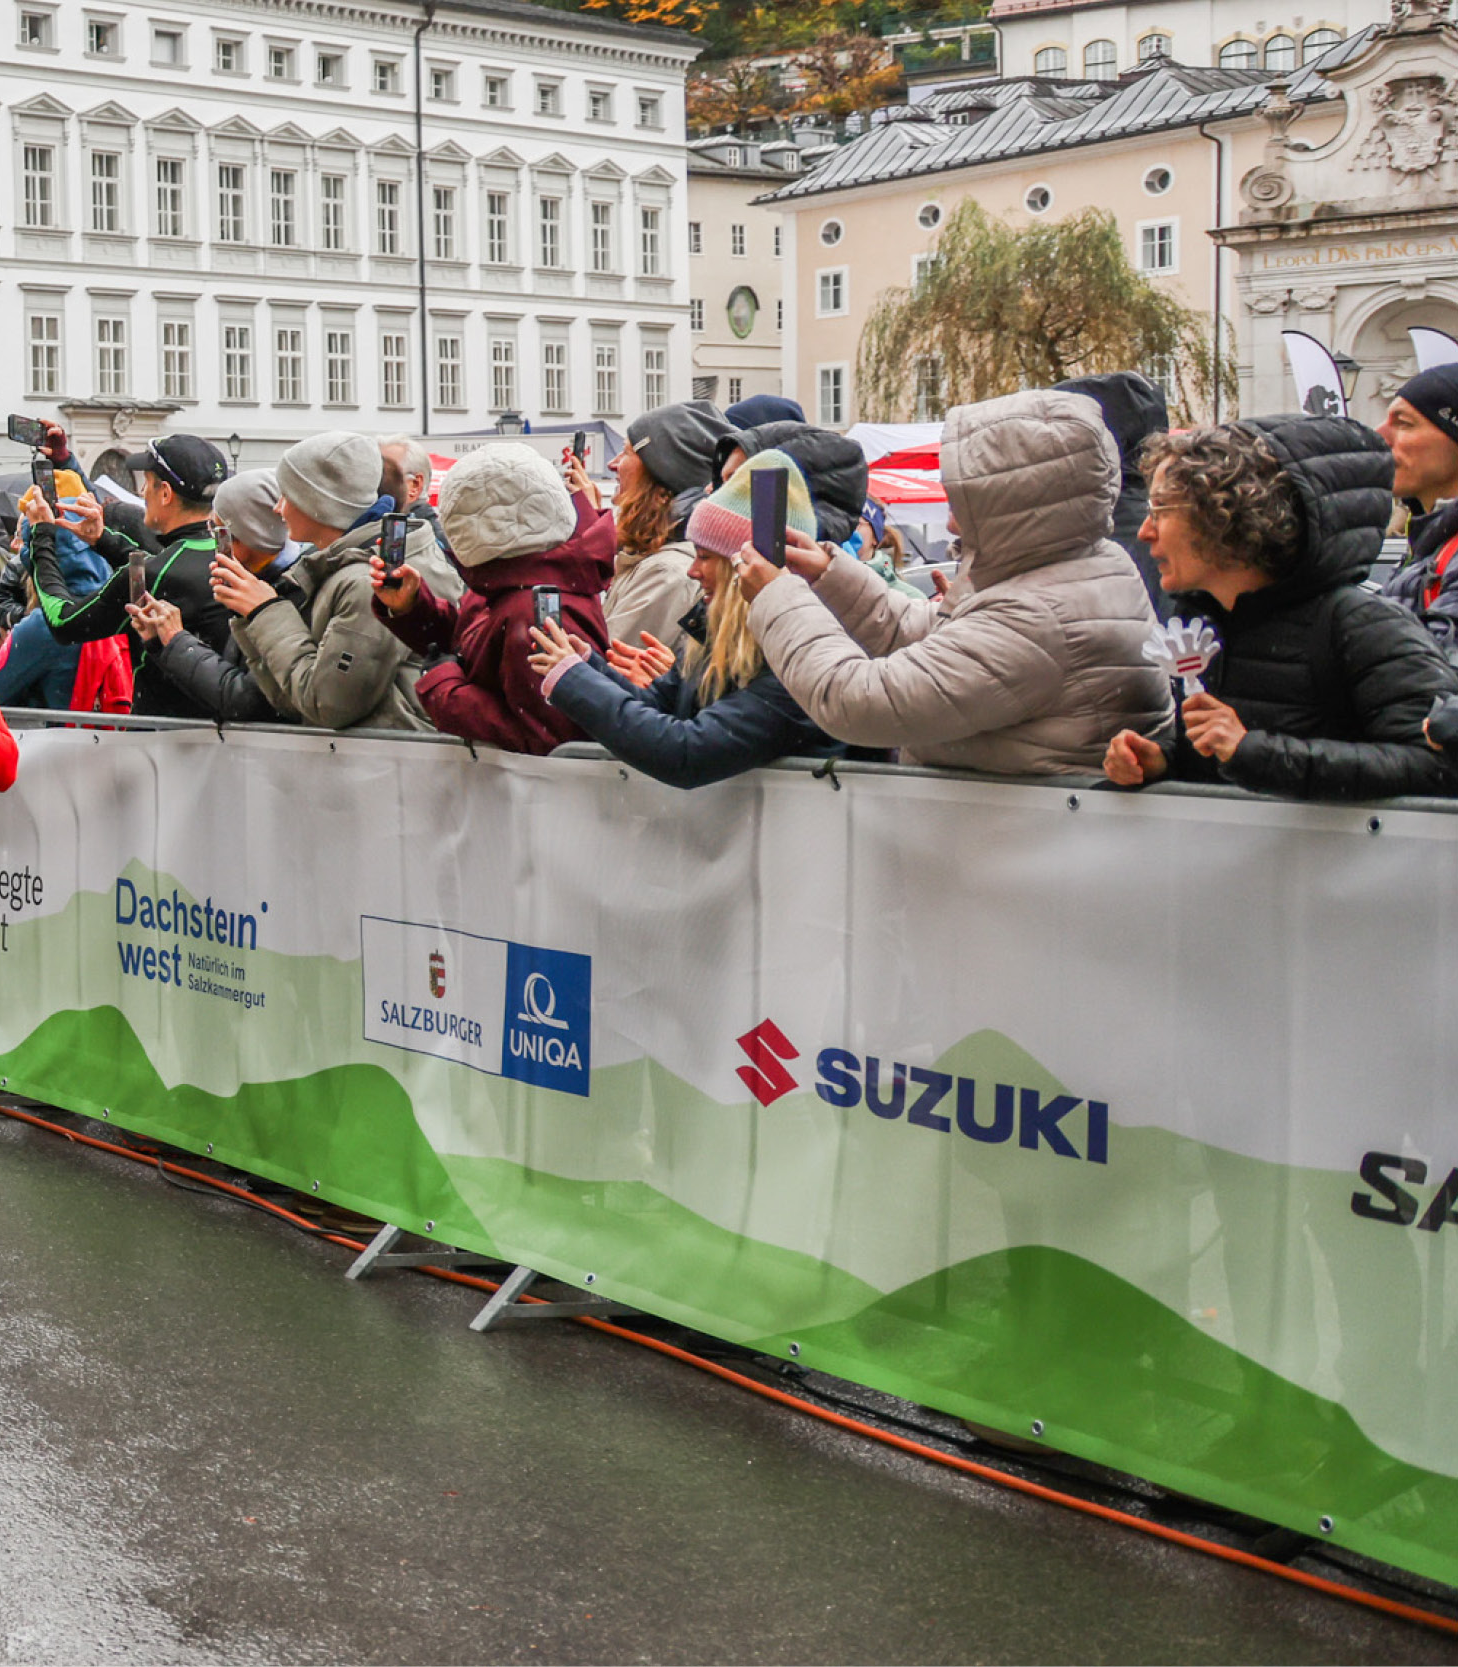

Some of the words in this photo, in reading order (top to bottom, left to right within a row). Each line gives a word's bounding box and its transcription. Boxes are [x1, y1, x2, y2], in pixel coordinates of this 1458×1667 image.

[116, 877, 257, 951] Dachstein
[117, 941, 182, 987] west
[188, 952, 229, 977] Natürlich
[231, 962, 245, 981] im
[188, 973, 266, 1009] Salzkammergut
[380, 1000, 483, 1047] SALZBURGER
[509, 1028, 583, 1071] UNIQA
[815, 1047, 1109, 1166] SUZUKI
